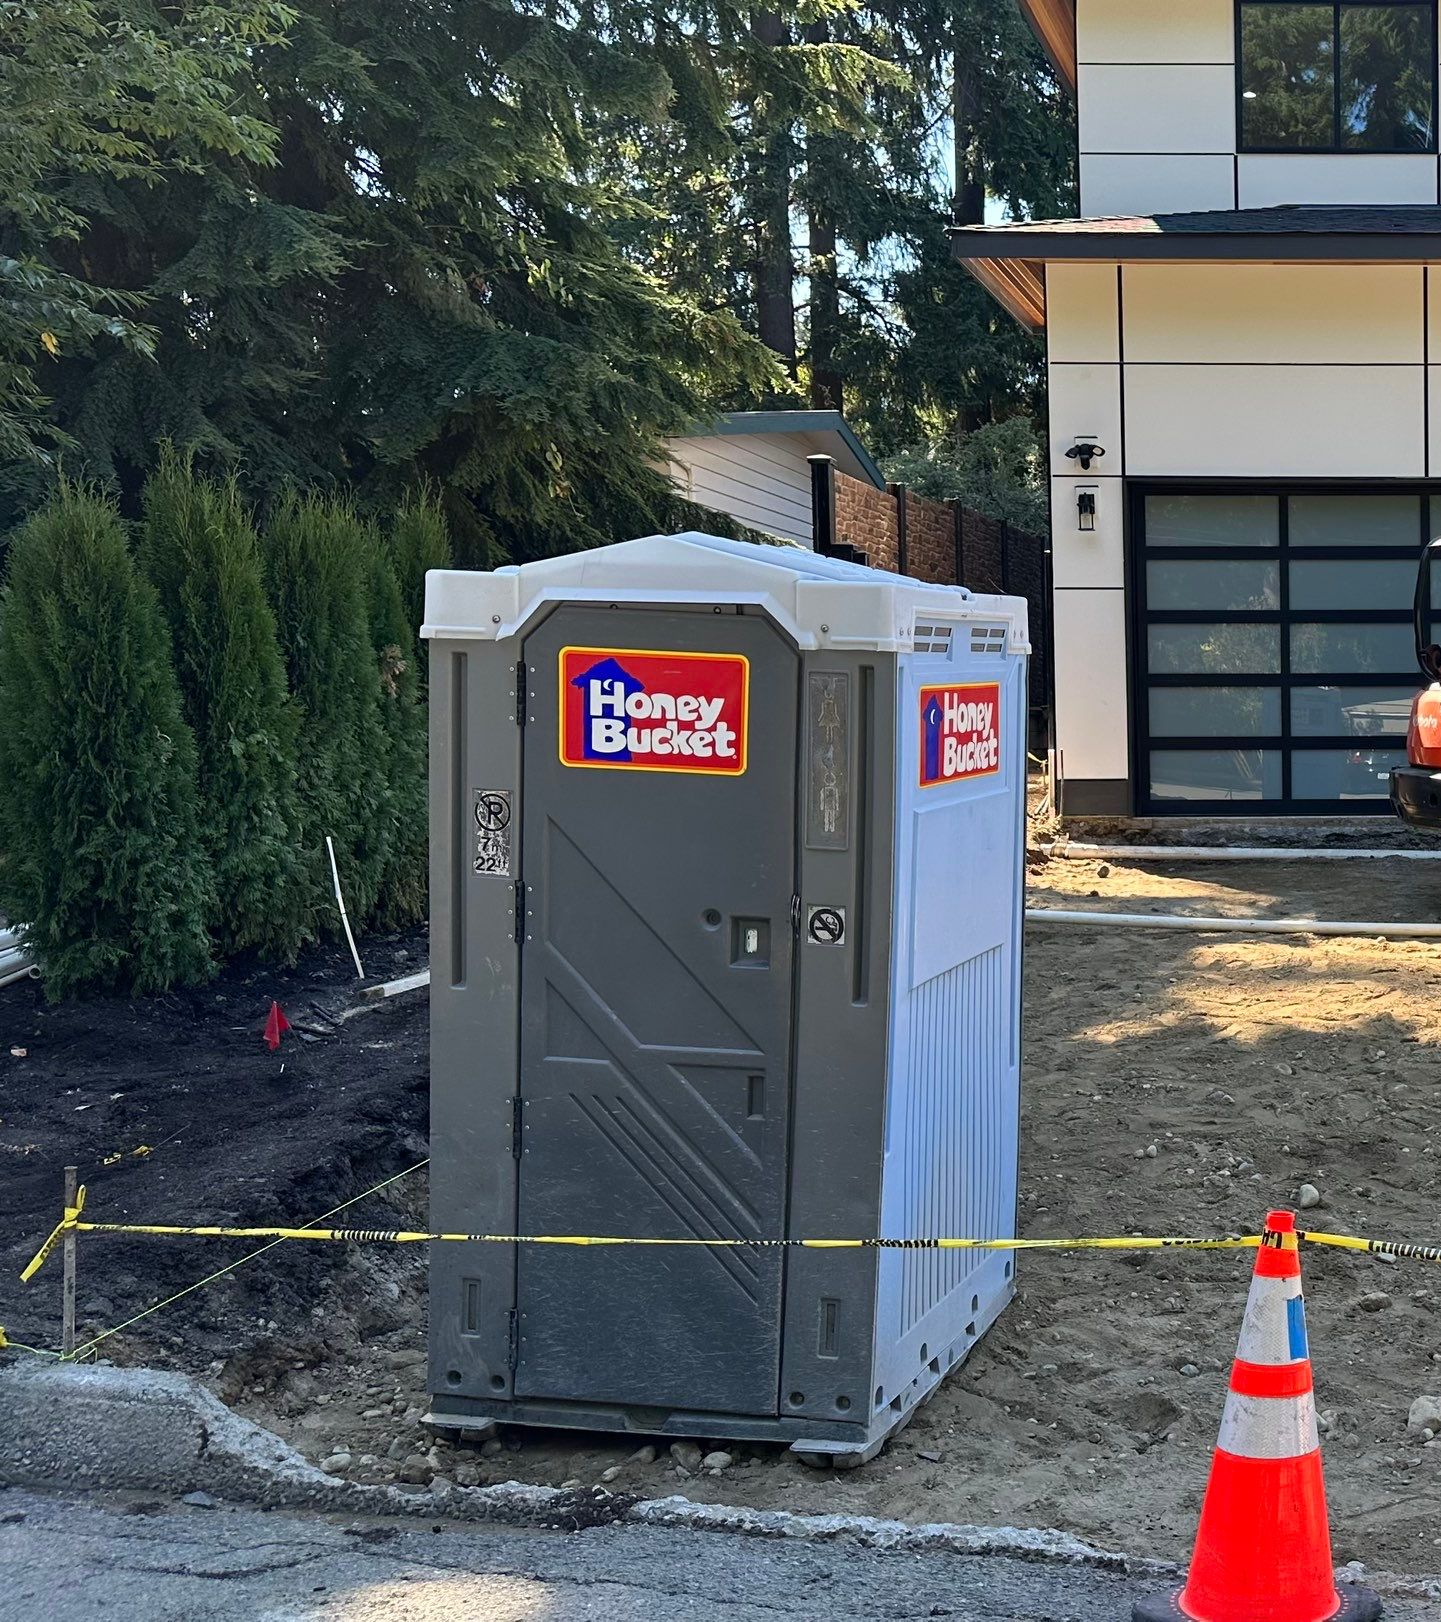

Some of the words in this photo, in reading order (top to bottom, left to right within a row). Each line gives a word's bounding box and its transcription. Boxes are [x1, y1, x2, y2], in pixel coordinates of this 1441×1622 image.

[589, 678, 725, 730] Honey
[943, 692, 993, 740] Honey
[590, 718, 737, 758] Bucket
[943, 728, 998, 777] Bucket
